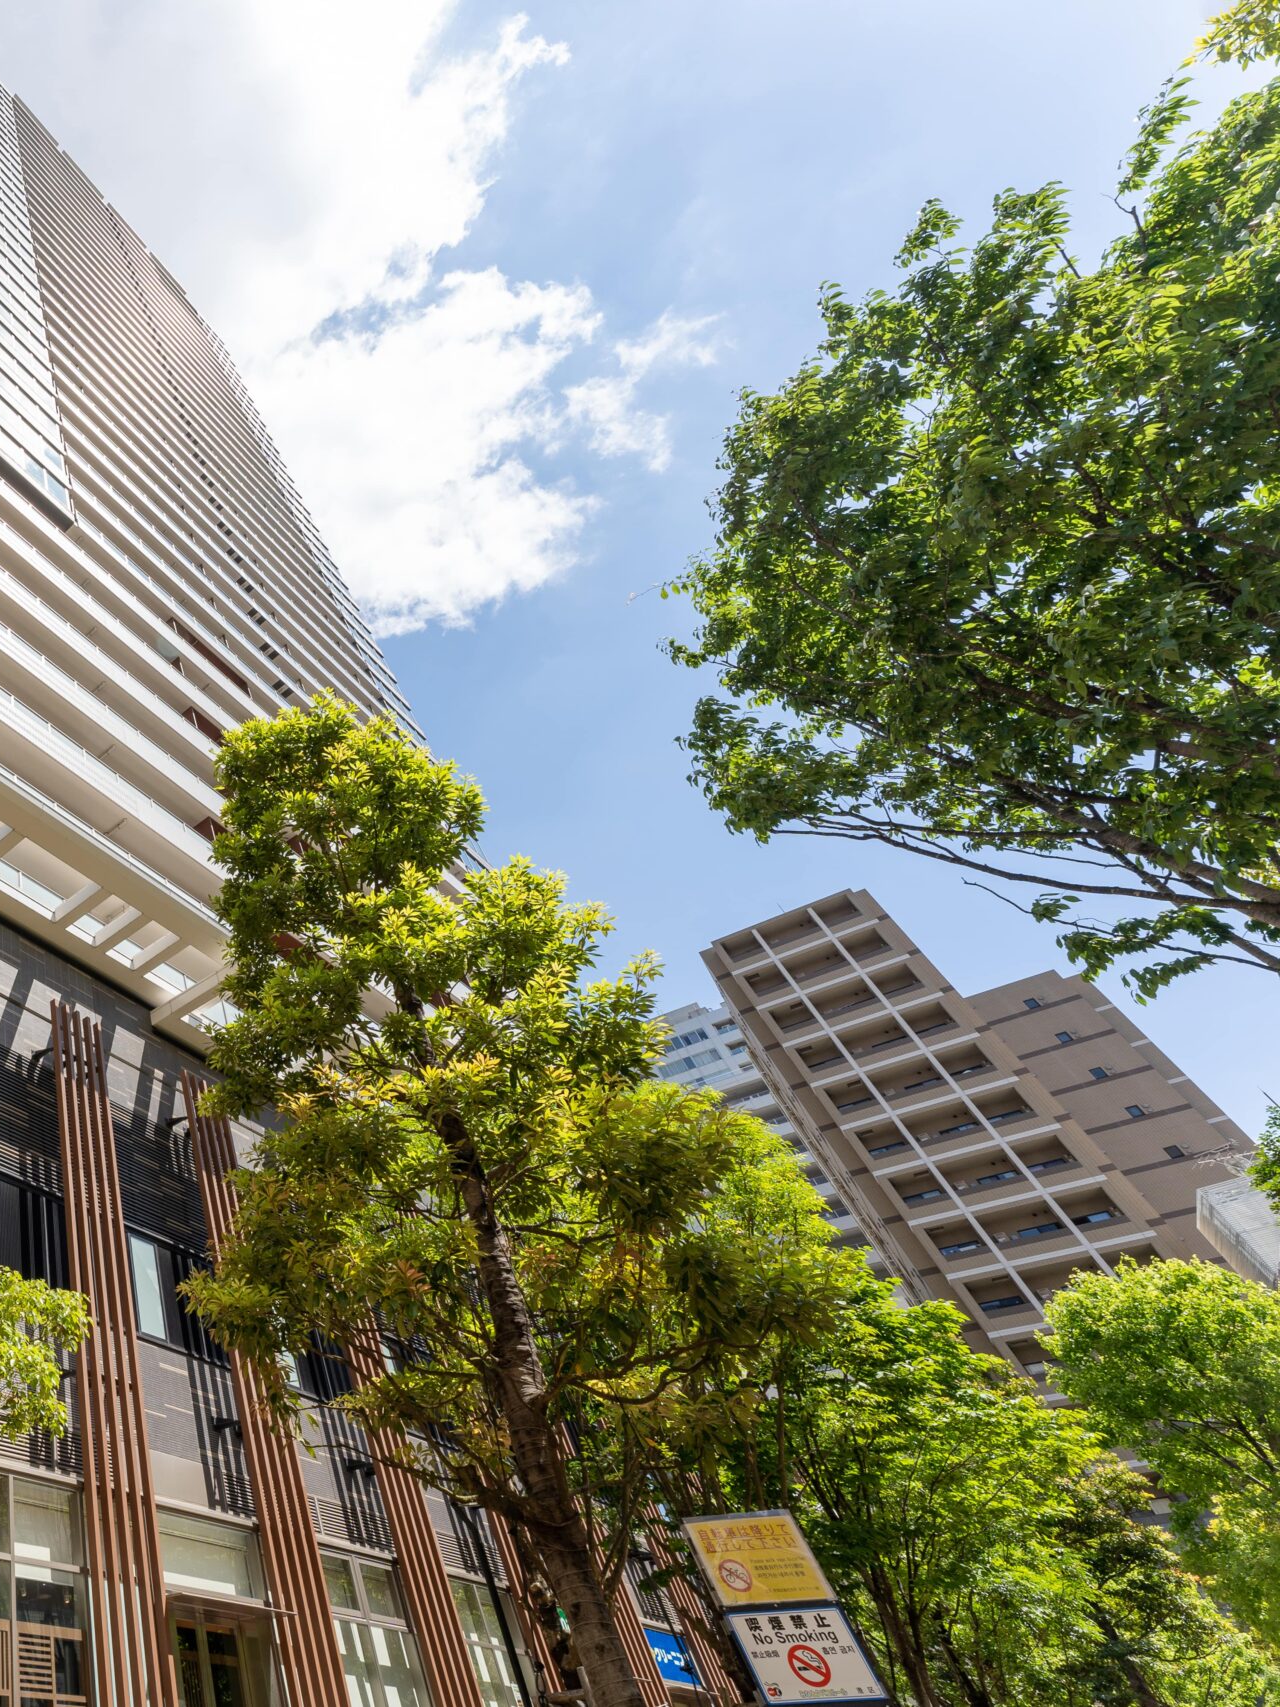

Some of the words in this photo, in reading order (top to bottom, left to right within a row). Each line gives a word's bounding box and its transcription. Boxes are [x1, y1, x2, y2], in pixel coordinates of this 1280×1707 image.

[697, 1523, 789, 1540] 自転車は降りて
[703, 1536, 797, 1552] 通行して下さい
[745, 1613, 831, 1632] 喫煙禁止
[752, 1632, 774, 1645] No
[775, 1629, 839, 1644] Smoking
